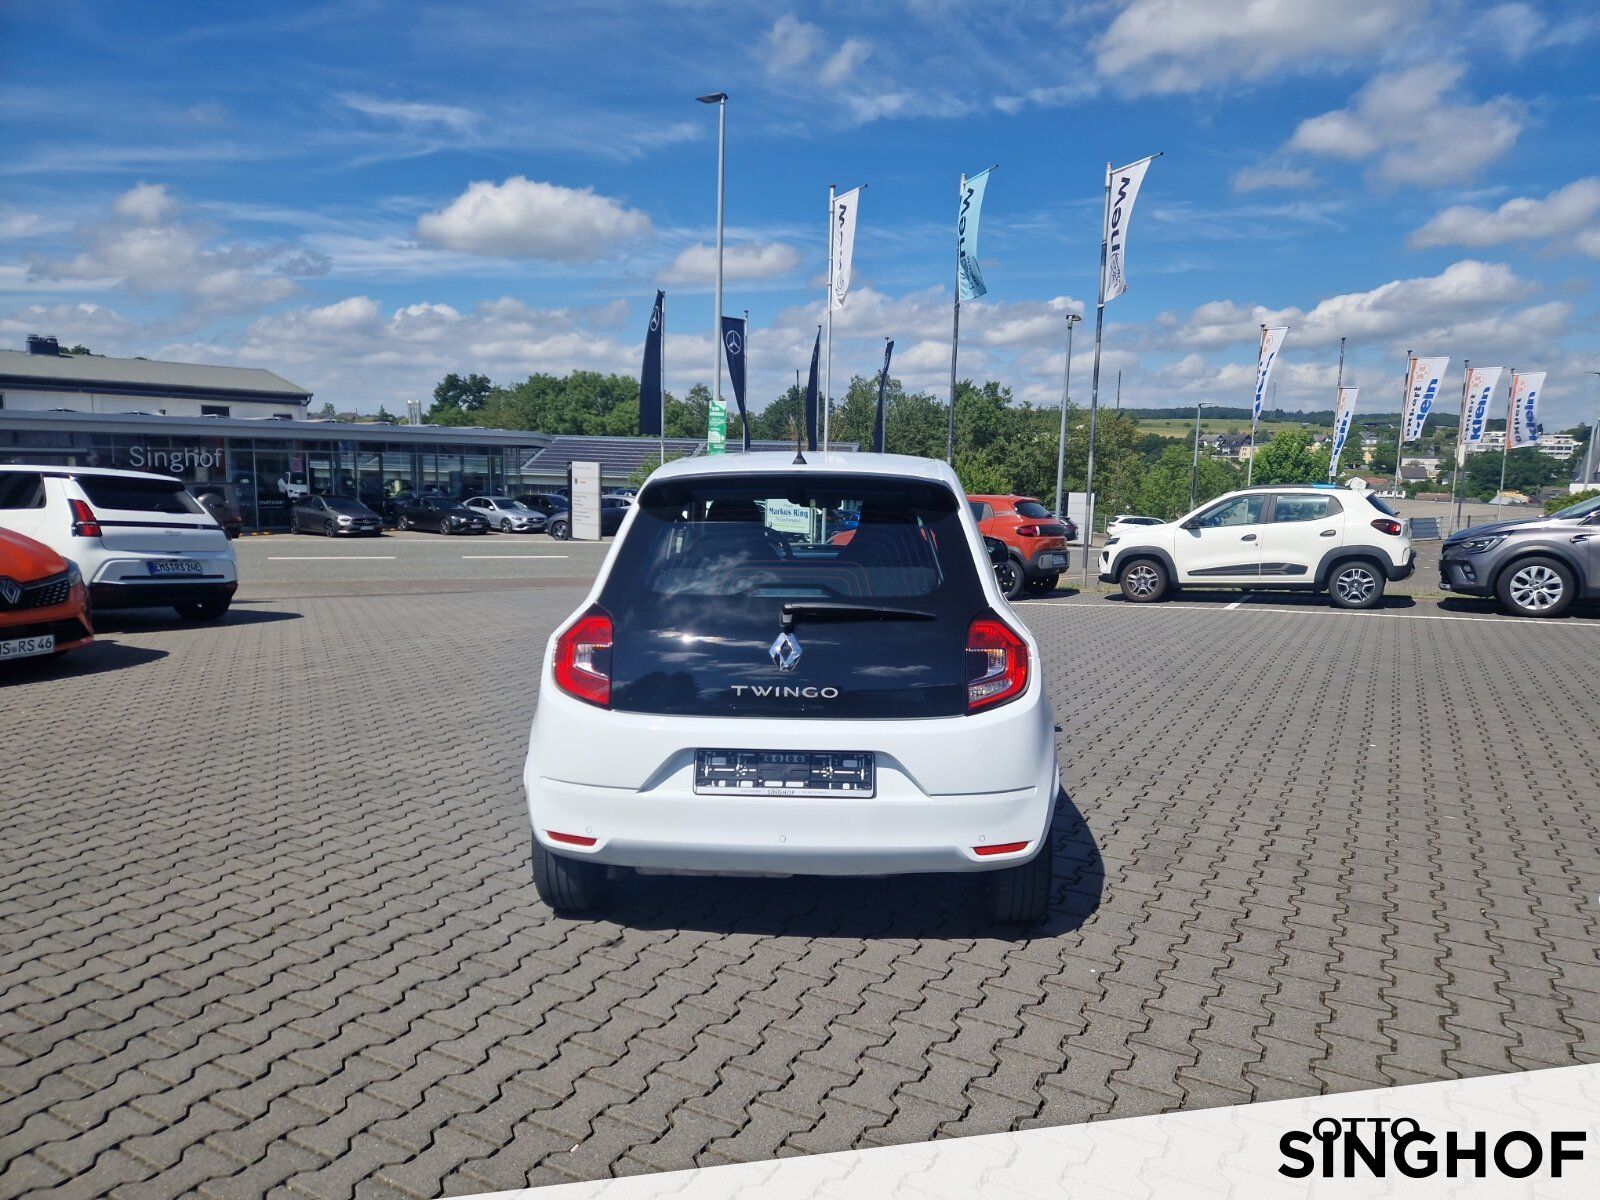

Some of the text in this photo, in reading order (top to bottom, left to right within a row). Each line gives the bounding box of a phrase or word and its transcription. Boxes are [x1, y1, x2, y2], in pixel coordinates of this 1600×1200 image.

[1470, 386, 1490, 440] klein
[1524, 391, 1538, 440] klein
[129, 446, 222, 472] Singhof
[769, 507, 792, 516] Markus
[18, 639, 35, 652] RS
[38, 637, 52, 649] 46
[731, 685, 839, 698] TWINGO
